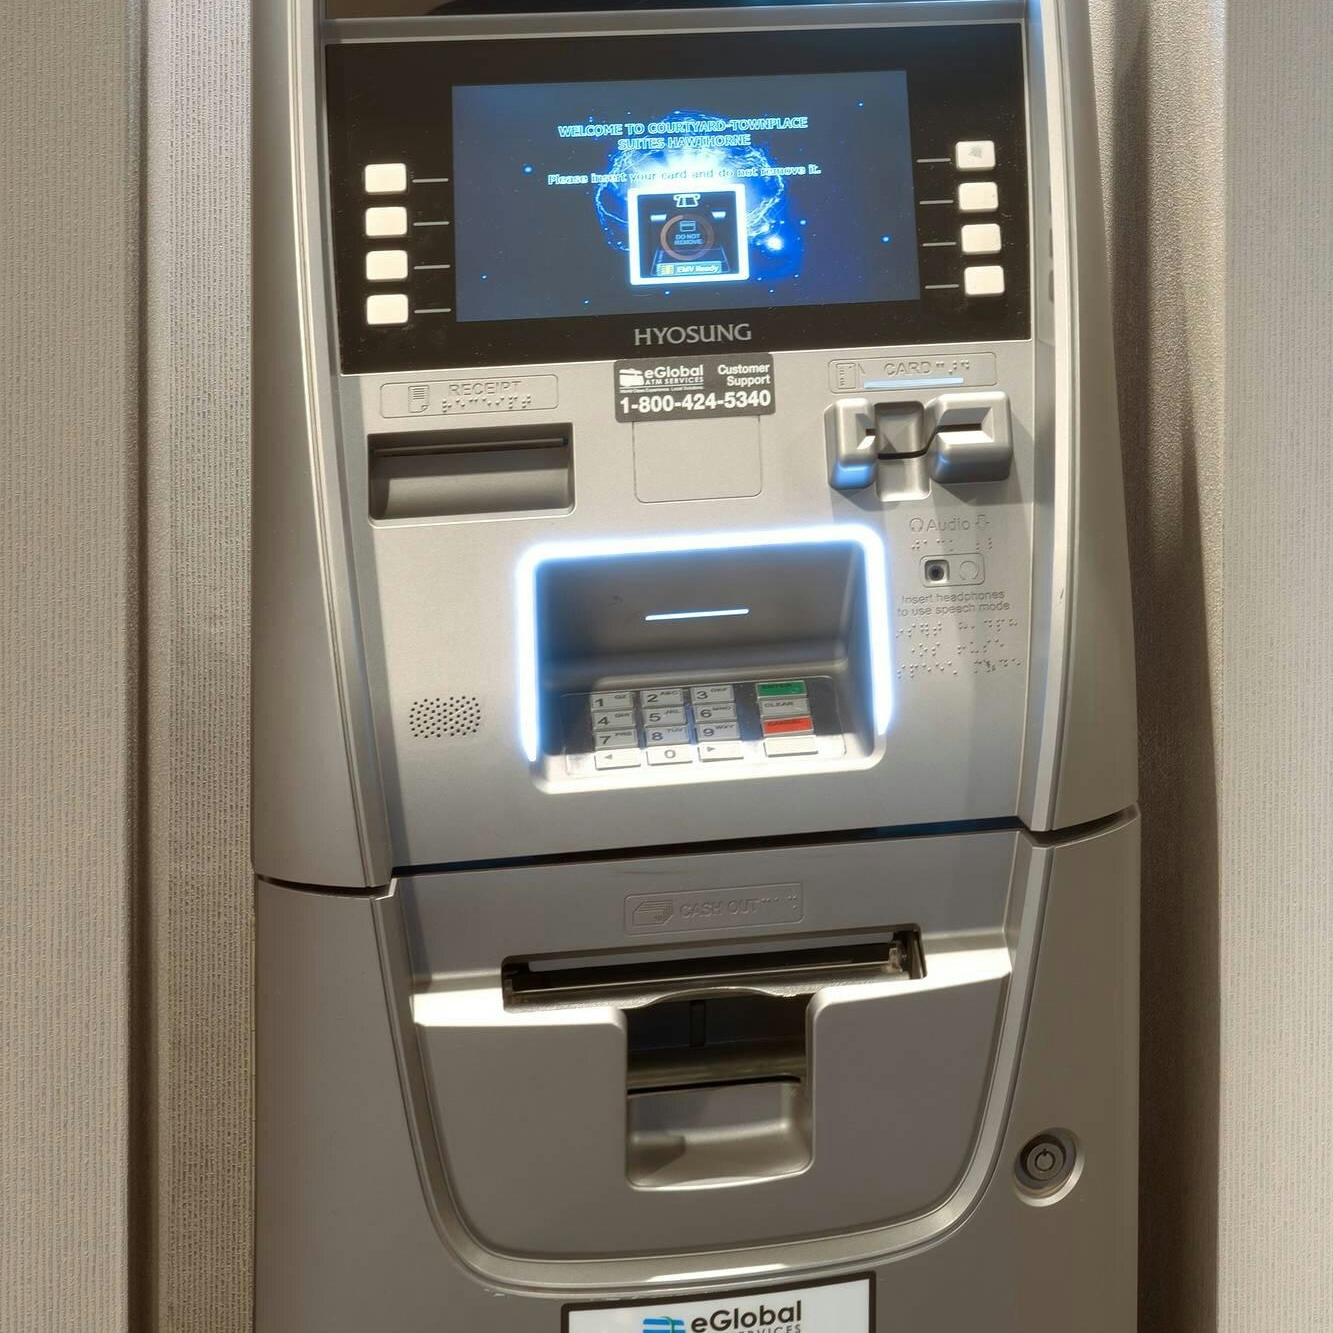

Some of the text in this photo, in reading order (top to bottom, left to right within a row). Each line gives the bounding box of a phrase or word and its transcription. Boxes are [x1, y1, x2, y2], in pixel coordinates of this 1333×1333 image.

[558, 116, 809, 138] WELCOME TO COURTYARD-TOWNPLACE
[618, 134, 751, 151] SUITES HAWTHORNE
[548, 163, 822, 185] Please insert your card and do not remove it.
[634, 323, 752, 346] HYOSUNG
[644, 364, 704, 379] eGlobal
[717, 364, 771, 375] Customer
[884, 361, 932, 376] CARD
[449, 380, 522, 396] RECEIPT
[645, 376, 704, 386] ATM SERVICES
[726, 374, 771, 388] Support
[619, 389, 771, 414] 1-800-424-5340
[927, 517, 971, 532] Audio
[902, 590, 1005, 605] Insert headphones
[897, 600, 1010, 617] to use speech mode
[595, 698, 604, 707] 1
[647, 694, 659, 703] 2
[696, 690, 708, 700] 3
[598, 716, 610, 725] 4
[649, 712, 661, 722] 5
[700, 708, 712, 718] 6
[600, 735, 611, 745] 7
[651, 731, 663, 741] 8
[702, 728, 714, 737] 9
[680, 901, 723, 918] CASH
[728, 898, 760, 915] OUT
[691, 1300, 802, 1333] eGlobal
